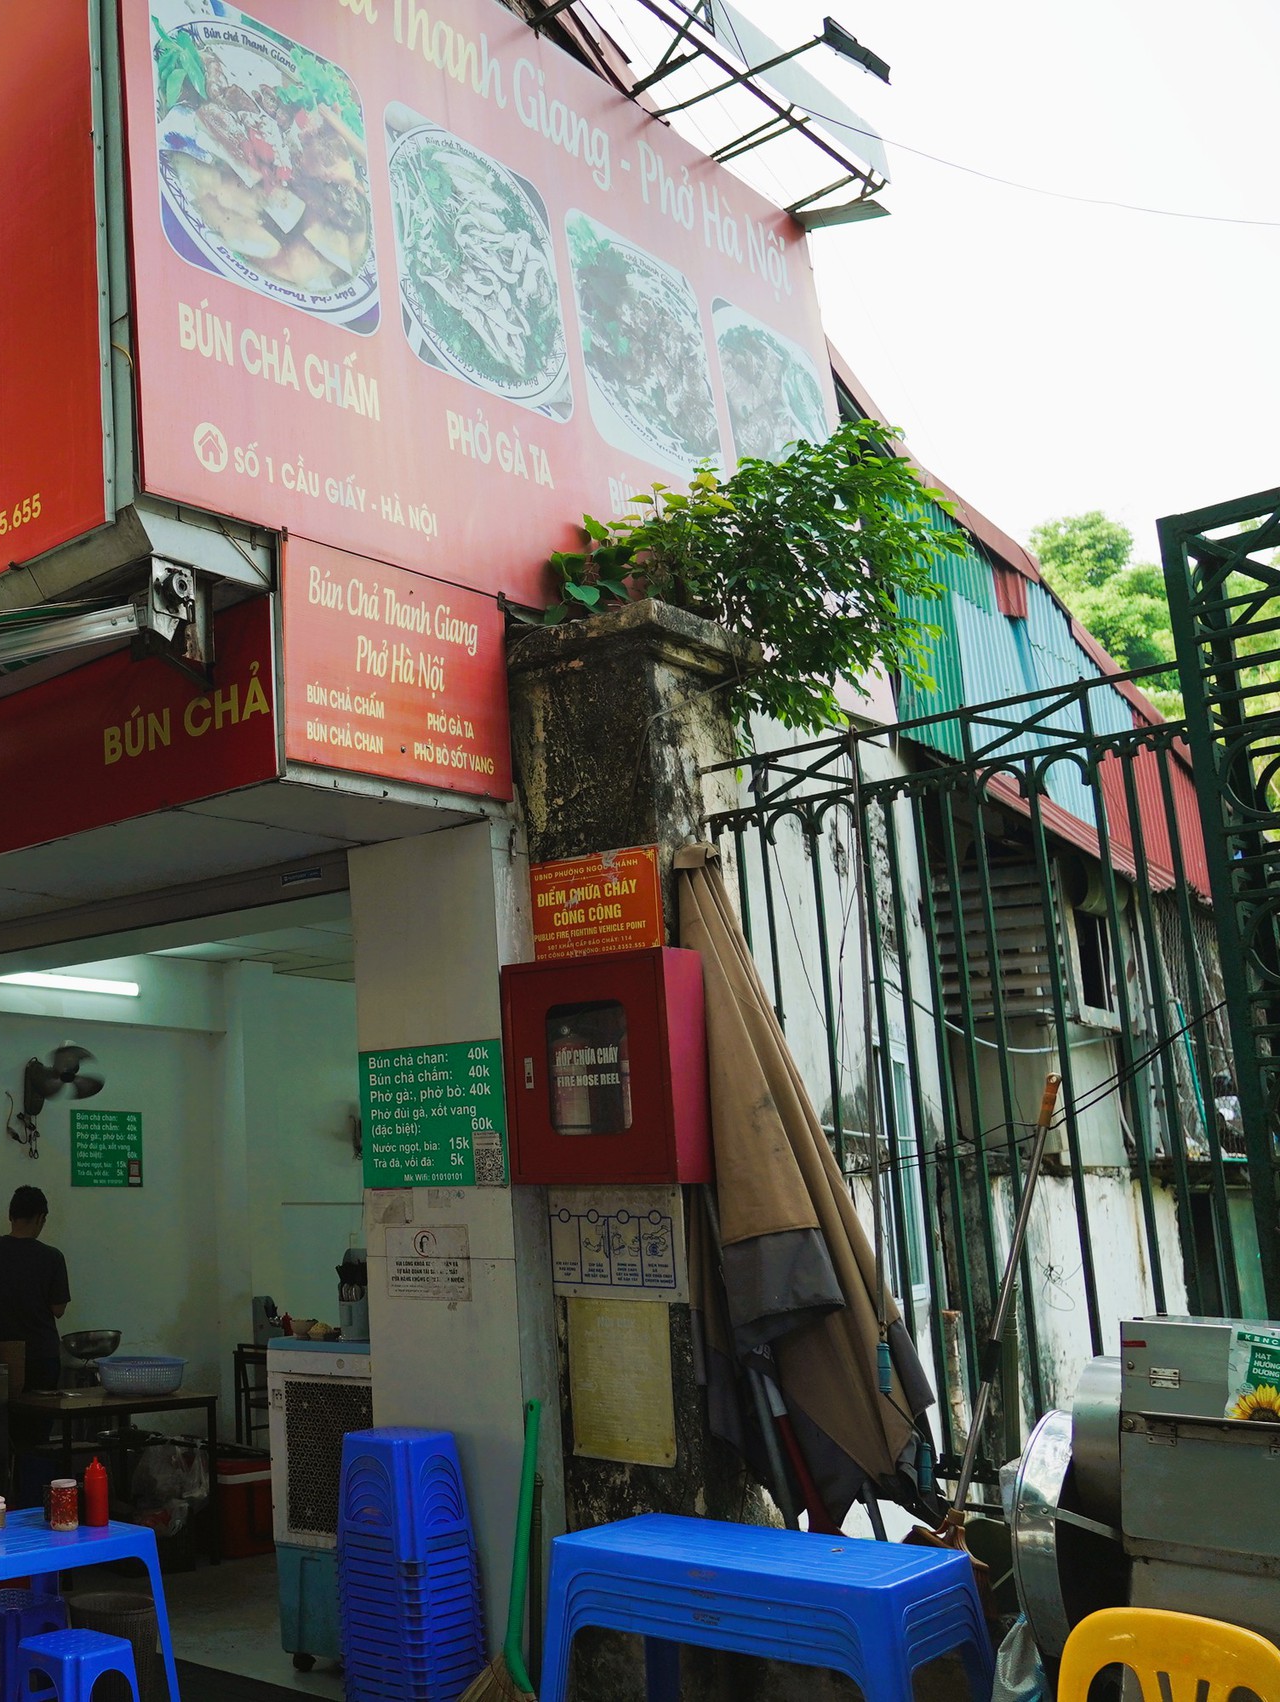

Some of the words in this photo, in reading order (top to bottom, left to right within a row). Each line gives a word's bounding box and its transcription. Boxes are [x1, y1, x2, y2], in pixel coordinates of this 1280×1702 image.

[241, 34, 268, 55] Thanh
[270, 49, 296, 73] Giang
[387, 0, 506, 109] Thanh
[513, 57, 614, 191] Giang
[637, 140, 694, 232] Phở
[699, 182, 742, 257] Hà
[745, 214, 793, 303] Nội
[178, 298, 234, 367] BÚN
[240, 327, 300, 392] CHẢ
[304, 352, 380, 421] CHẤM
[446, 407, 492, 465] PHỞ
[495, 425, 529, 480] GÀ
[529, 444, 555, 489] TA
[234, 441, 260, 478] SỐ
[266, 456, 274, 484] 1
[281, 453, 319, 498] CẦU
[325, 474, 366, 513] GIẤY
[381, 492, 405, 526] HÀ
[408, 503, 438, 542] NỘI
[308, 565, 344, 611] Bún
[347, 578, 380, 622] Chả
[383, 588, 431, 636] Thanh
[434, 604, 478, 657] Giang
[356, 635, 389, 678] Phở
[391, 643, 415, 684] Hà
[418, 651, 445, 699] Nội
[103, 704, 172, 765] BÚN
[184, 660, 271, 738] CHẢ
[306, 681, 328, 706] BÚN
[330, 687, 352, 713] CHẢ
[354, 691, 385, 719] CHẤM
[306, 717, 328, 743] BÚN
[330, 723, 352, 749] CHẢ
[354, 730, 384, 754] CHAN
[427, 709, 448, 733] PHỞ
[448, 714, 464, 737] GÀ
[464, 721, 475, 740] TA
[414, 739, 435, 763] PHỞ
[436, 743, 450, 766] BÒ
[451, 745, 470, 770] SỐT
[469, 755, 495, 776] VANG
[537, 886, 566, 908] ĐIỂM
[604, 877, 637, 898] CHÁY
[553, 908, 585, 927] CÔNG
[588, 903, 622, 924] CỘNG
[534, 932, 555, 943] PUBLIC
[556, 929, 569, 940] FIRE
[570, 926, 598, 939] FIGHTING
[599, 922, 625, 935] VEHICLE
[626, 920, 646, 930] POINT
[369, 1056, 390, 1069] Bún
[394, 1053, 413, 1067] chả
[417, 1052, 449, 1064] chan:
[468, 1047, 489, 1060] 40k
[597, 1044, 618, 1064] CHÁY
[369, 1073, 391, 1086] Bún
[394, 1070, 414, 1084] chả
[418, 1067, 453, 1082] chấm:
[469, 1065, 490, 1078] 40k
[447, 1085, 466, 1098] bò:
[469, 1083, 491, 1096] 40k
[557, 1075, 576, 1088] FIRE
[576, 1074, 599, 1087] HOSE
[600, 1073, 620, 1085] REEL
[394, 1107, 410, 1119] đùi
[413, 1106, 428, 1120] gà,
[431, 1102, 448, 1117] xốt
[451, 1105, 476, 1118] vang
[372, 1123, 393, 1138] (đặc
[396, 1122, 421, 1137] biệt):
[471, 1118, 493, 1131] 60k
[372, 1142, 397, 1153] Nước
[400, 1142, 421, 1154] ngọt,
[424, 1140, 441, 1151] bia:
[449, 1137, 470, 1150] 15k
[373, 1158, 387, 1168] Trà
[390, 1158, 403, 1169] đá,
[405, 1155, 419, 1167] vối
[421, 1156, 435, 1167] đá:
[450, 1153, 465, 1166] 5k
[404, 1174, 414, 1182] Mk
[415, 1173, 430, 1181] Wifi:
[431, 1172, 463, 1181] 01010101
